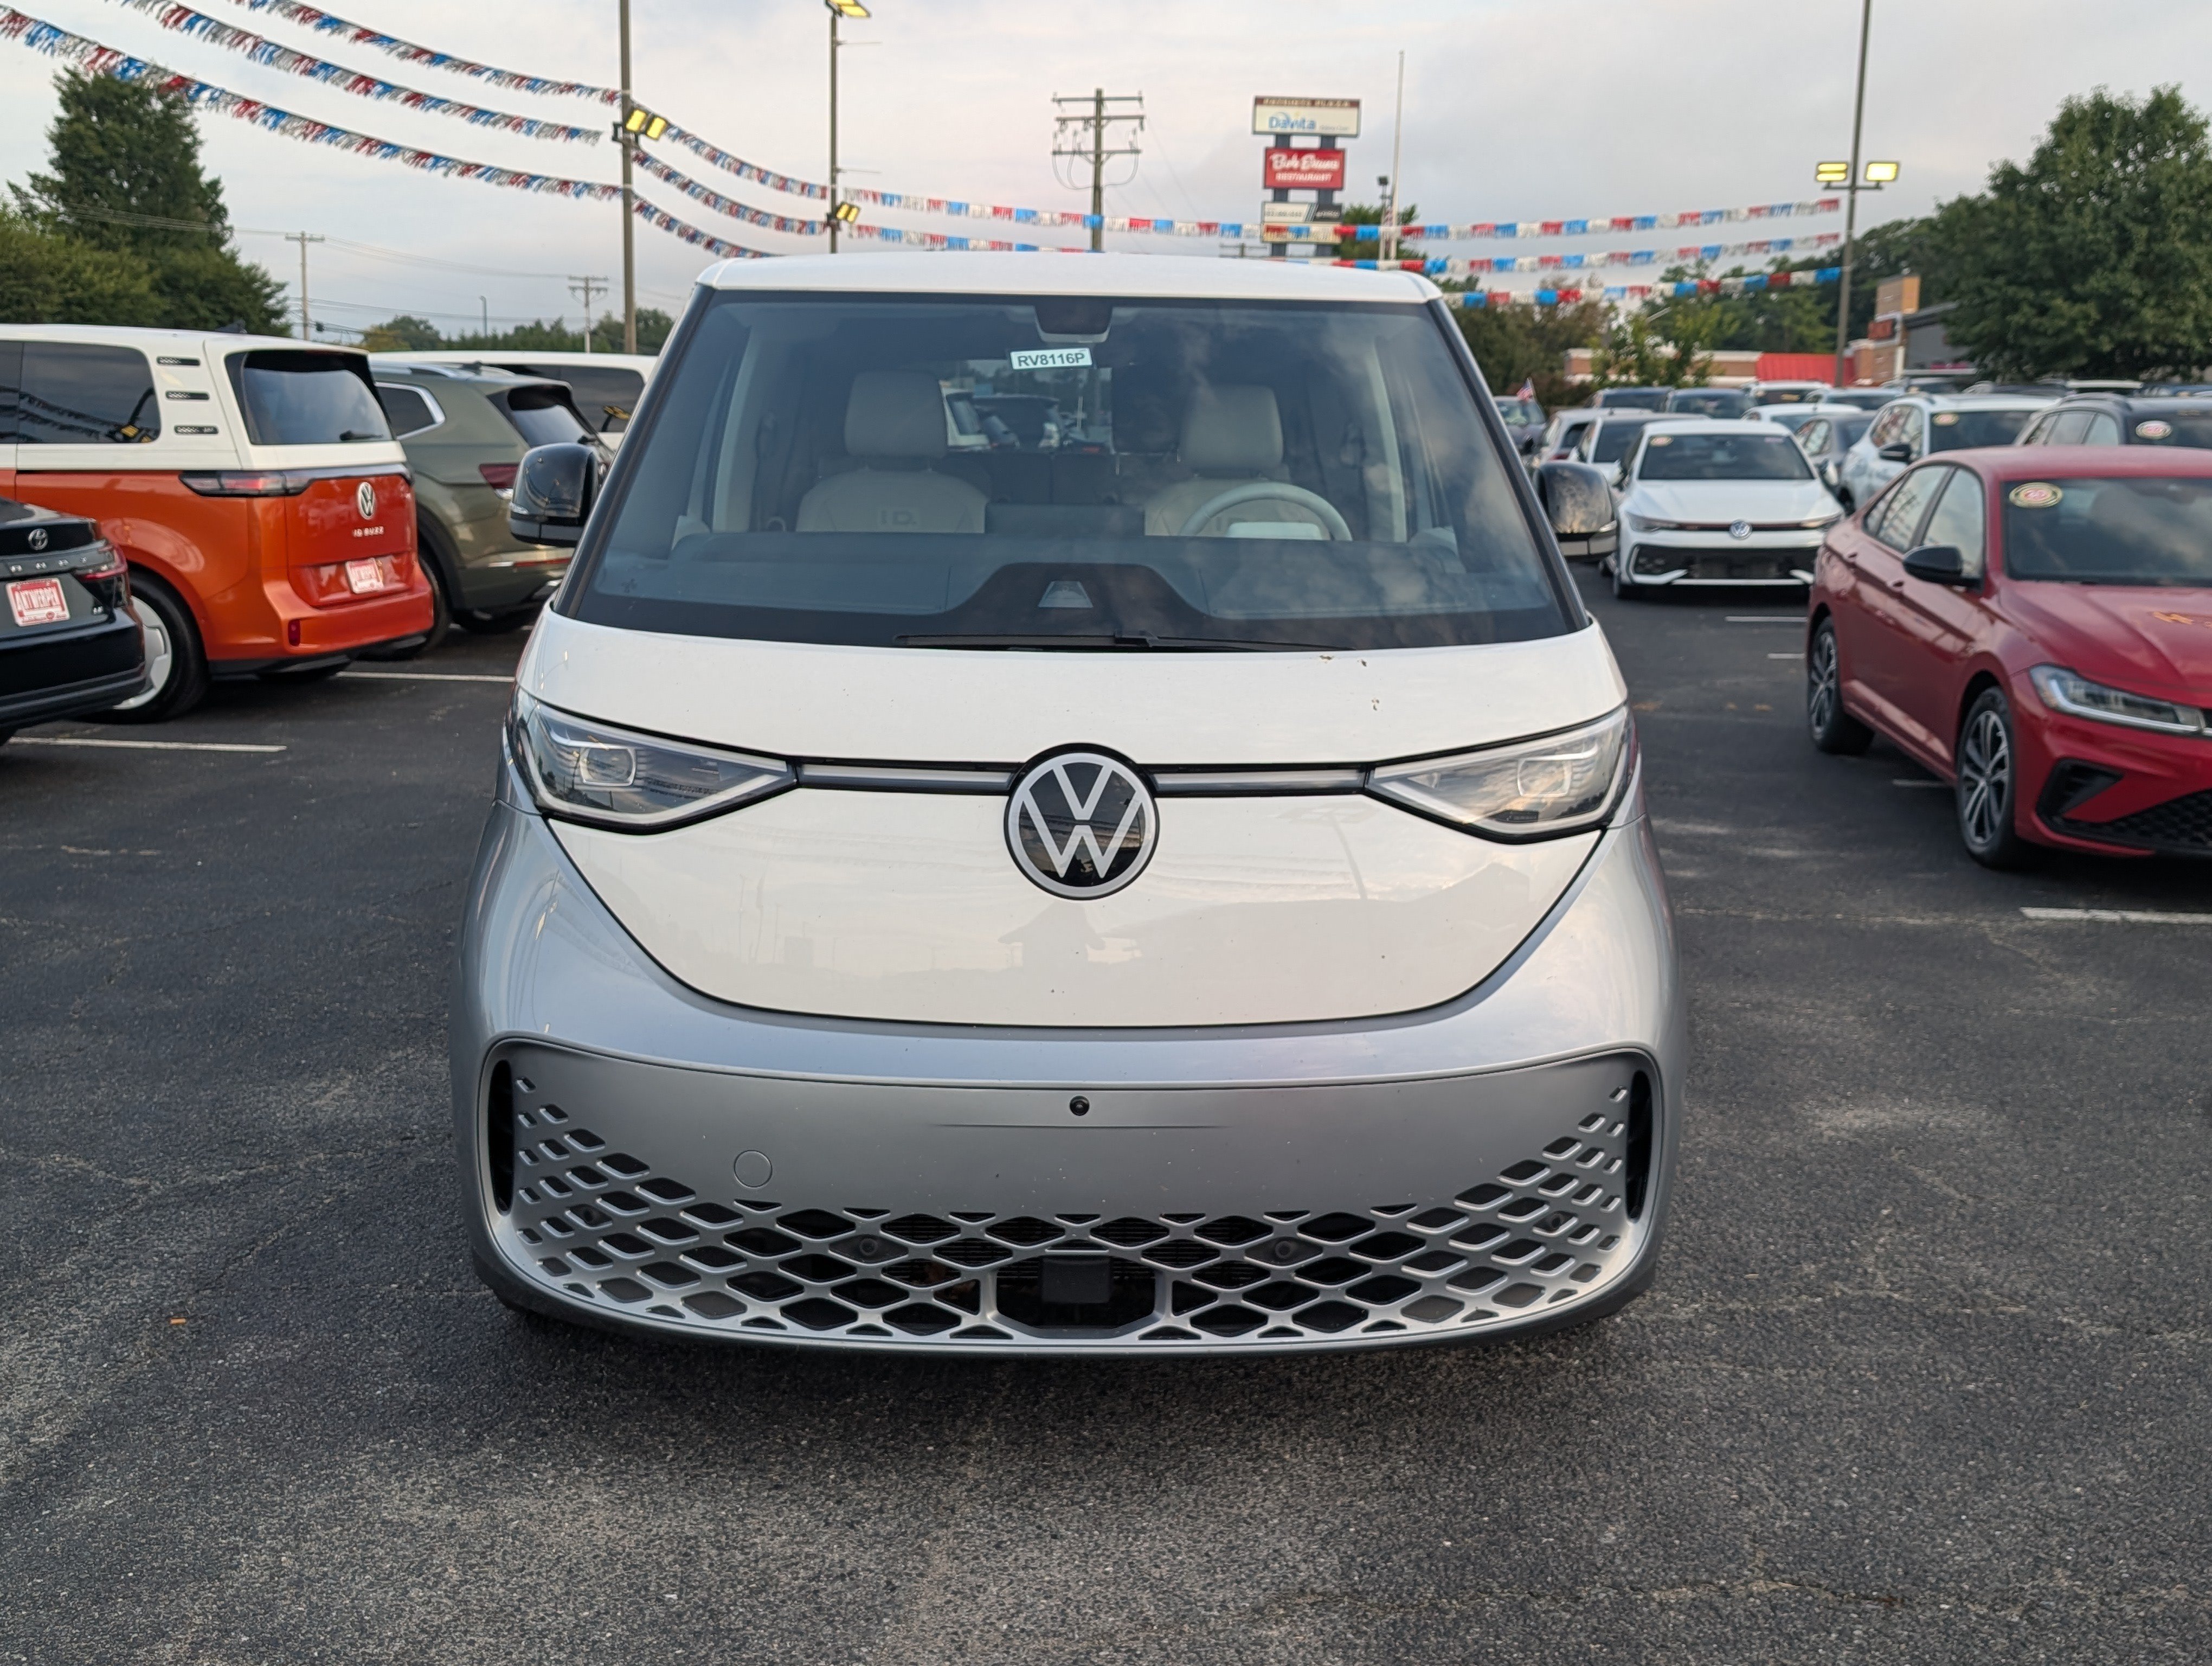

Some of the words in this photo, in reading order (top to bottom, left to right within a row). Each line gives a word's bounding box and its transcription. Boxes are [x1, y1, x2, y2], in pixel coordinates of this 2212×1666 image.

[1270, 153, 1300, 170] Bob
[1017, 353, 1085, 367] RV8116P
[1008, 752, 1156, 898] VW
